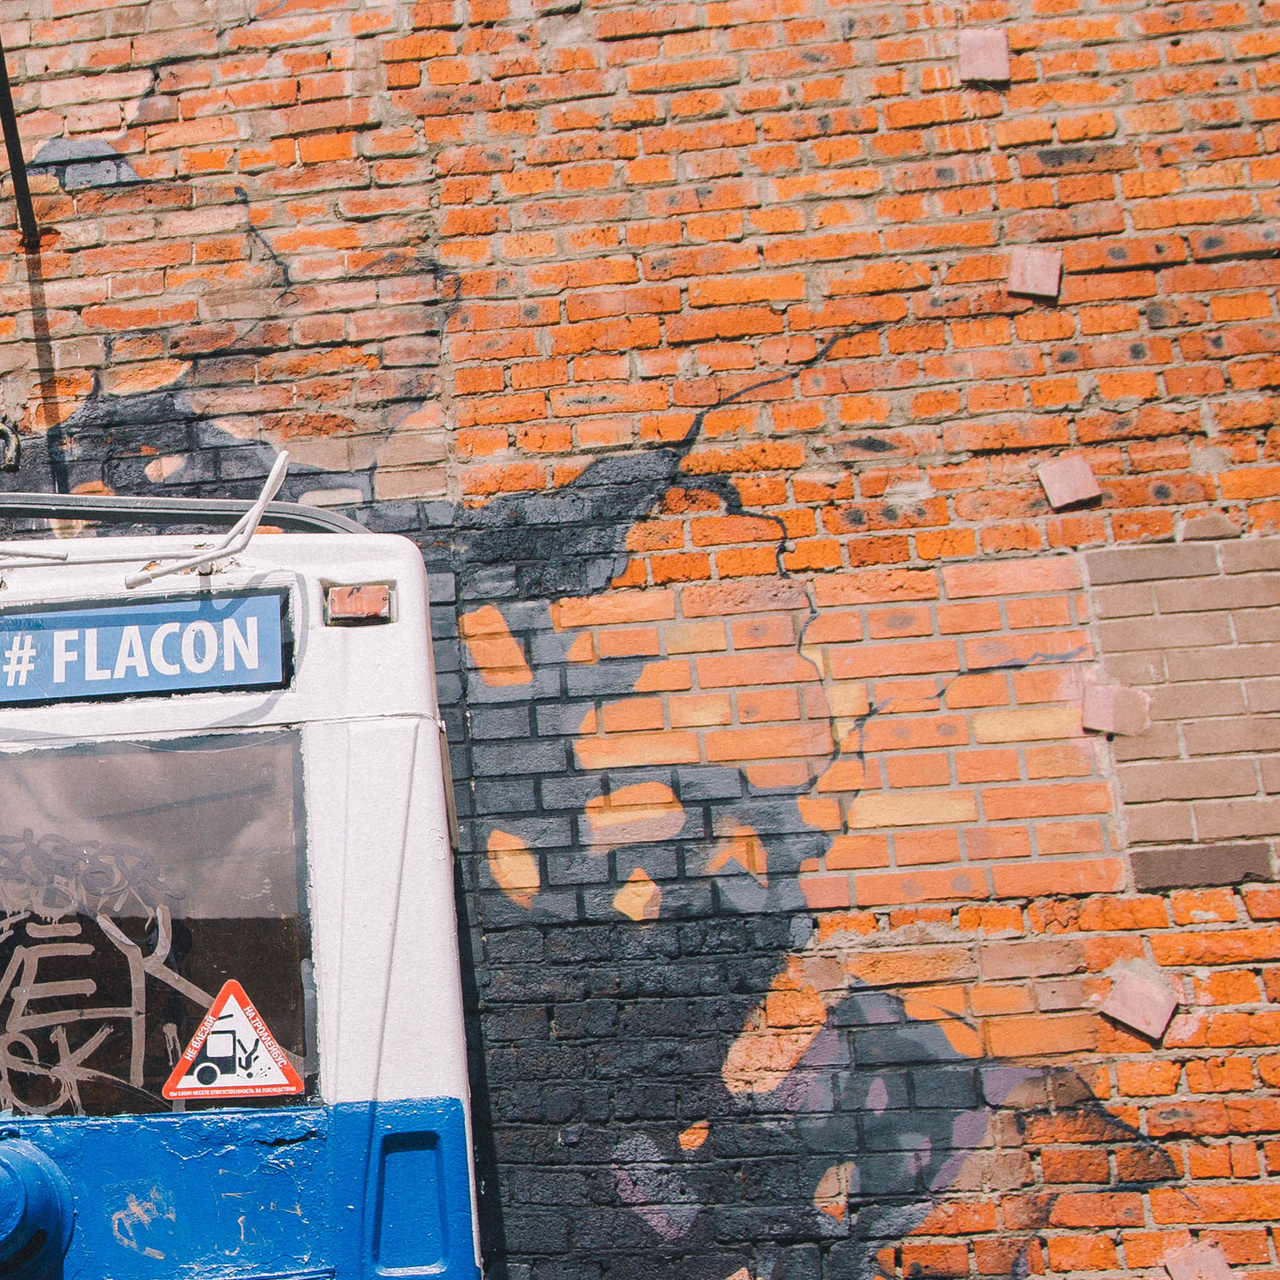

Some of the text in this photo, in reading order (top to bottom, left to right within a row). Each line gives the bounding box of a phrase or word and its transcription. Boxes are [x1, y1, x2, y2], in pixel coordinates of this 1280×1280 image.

[52, 616, 260, 684] FLACON
[184, 1014, 217, 1061] НЕ ВЛЕЗАЙ
[243, 1005, 287, 1068] НА ТРОЛЛЕЙБУС
